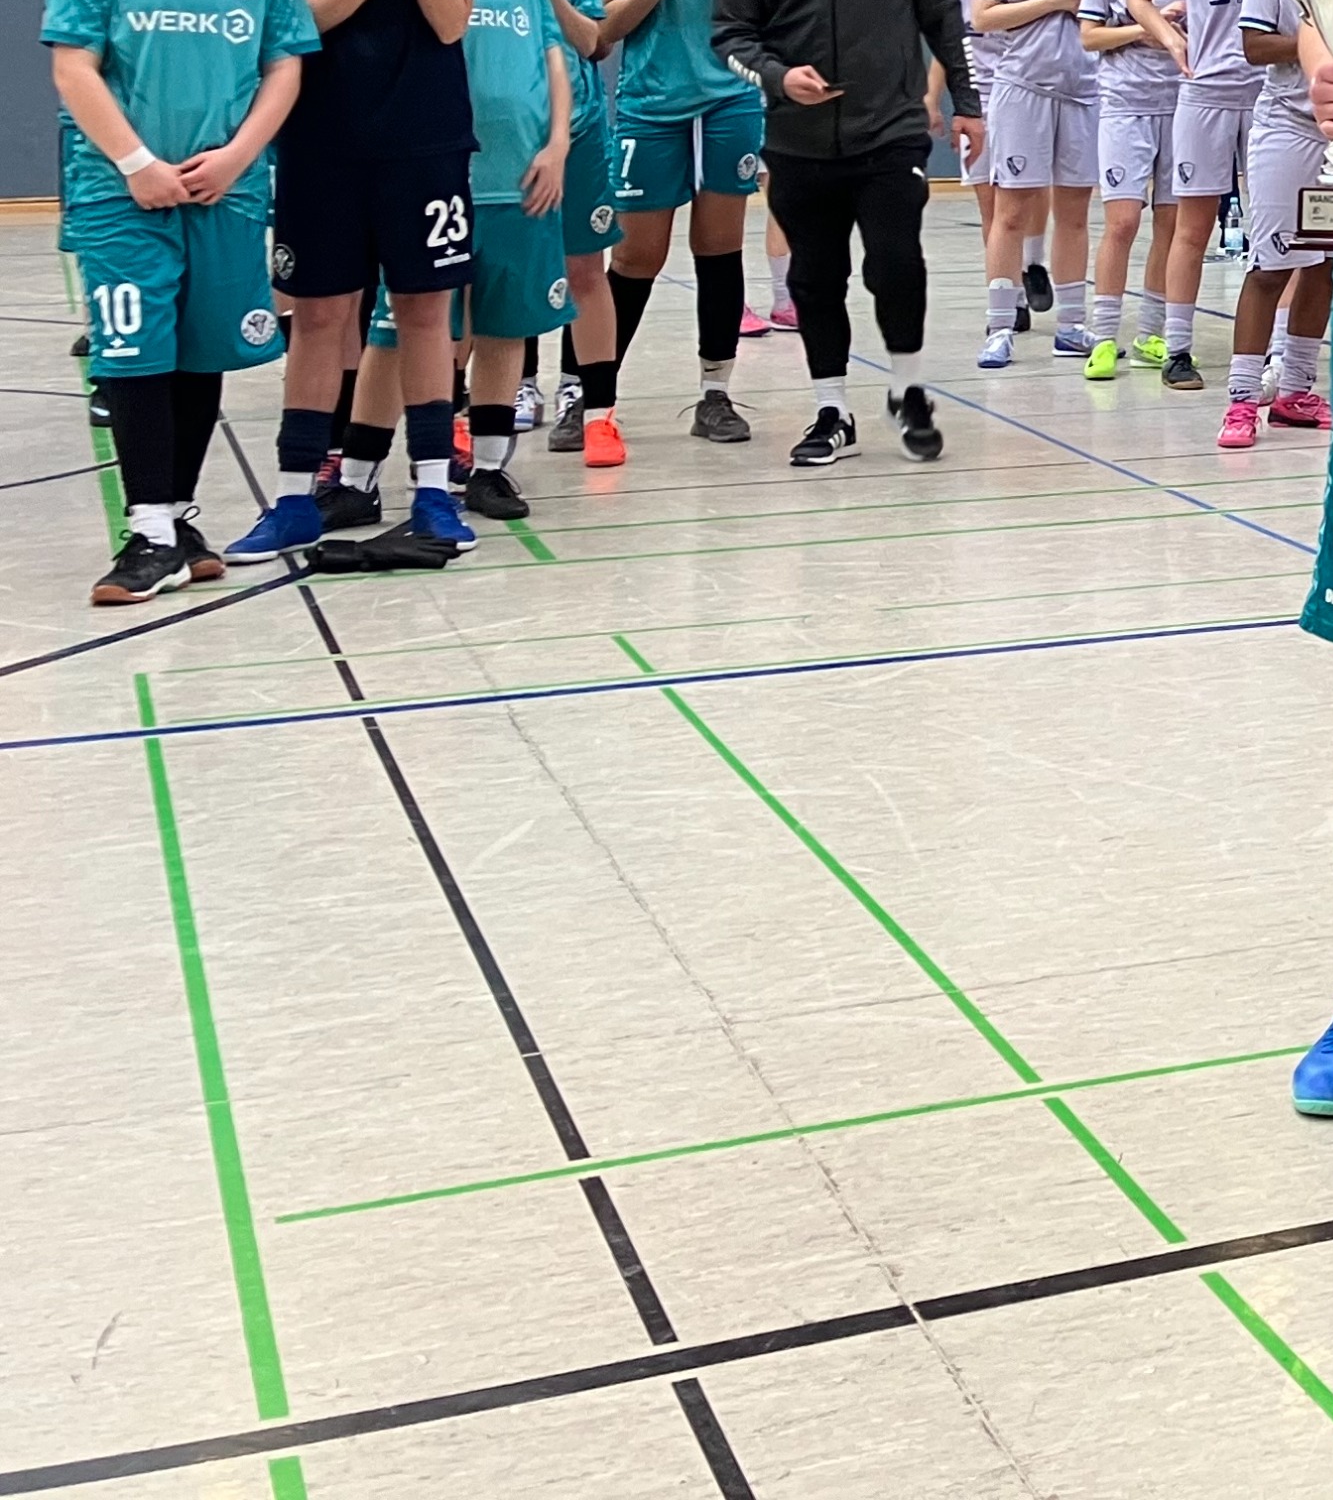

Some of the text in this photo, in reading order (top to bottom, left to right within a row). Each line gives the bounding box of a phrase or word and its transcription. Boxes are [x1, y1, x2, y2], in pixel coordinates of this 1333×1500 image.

[126, 10, 219, 34] WERK
[467, 8, 511, 28] ERK
[620, 138, 637, 179] 7
[424, 194, 469, 248] 23
[93, 282, 143, 336] 10
